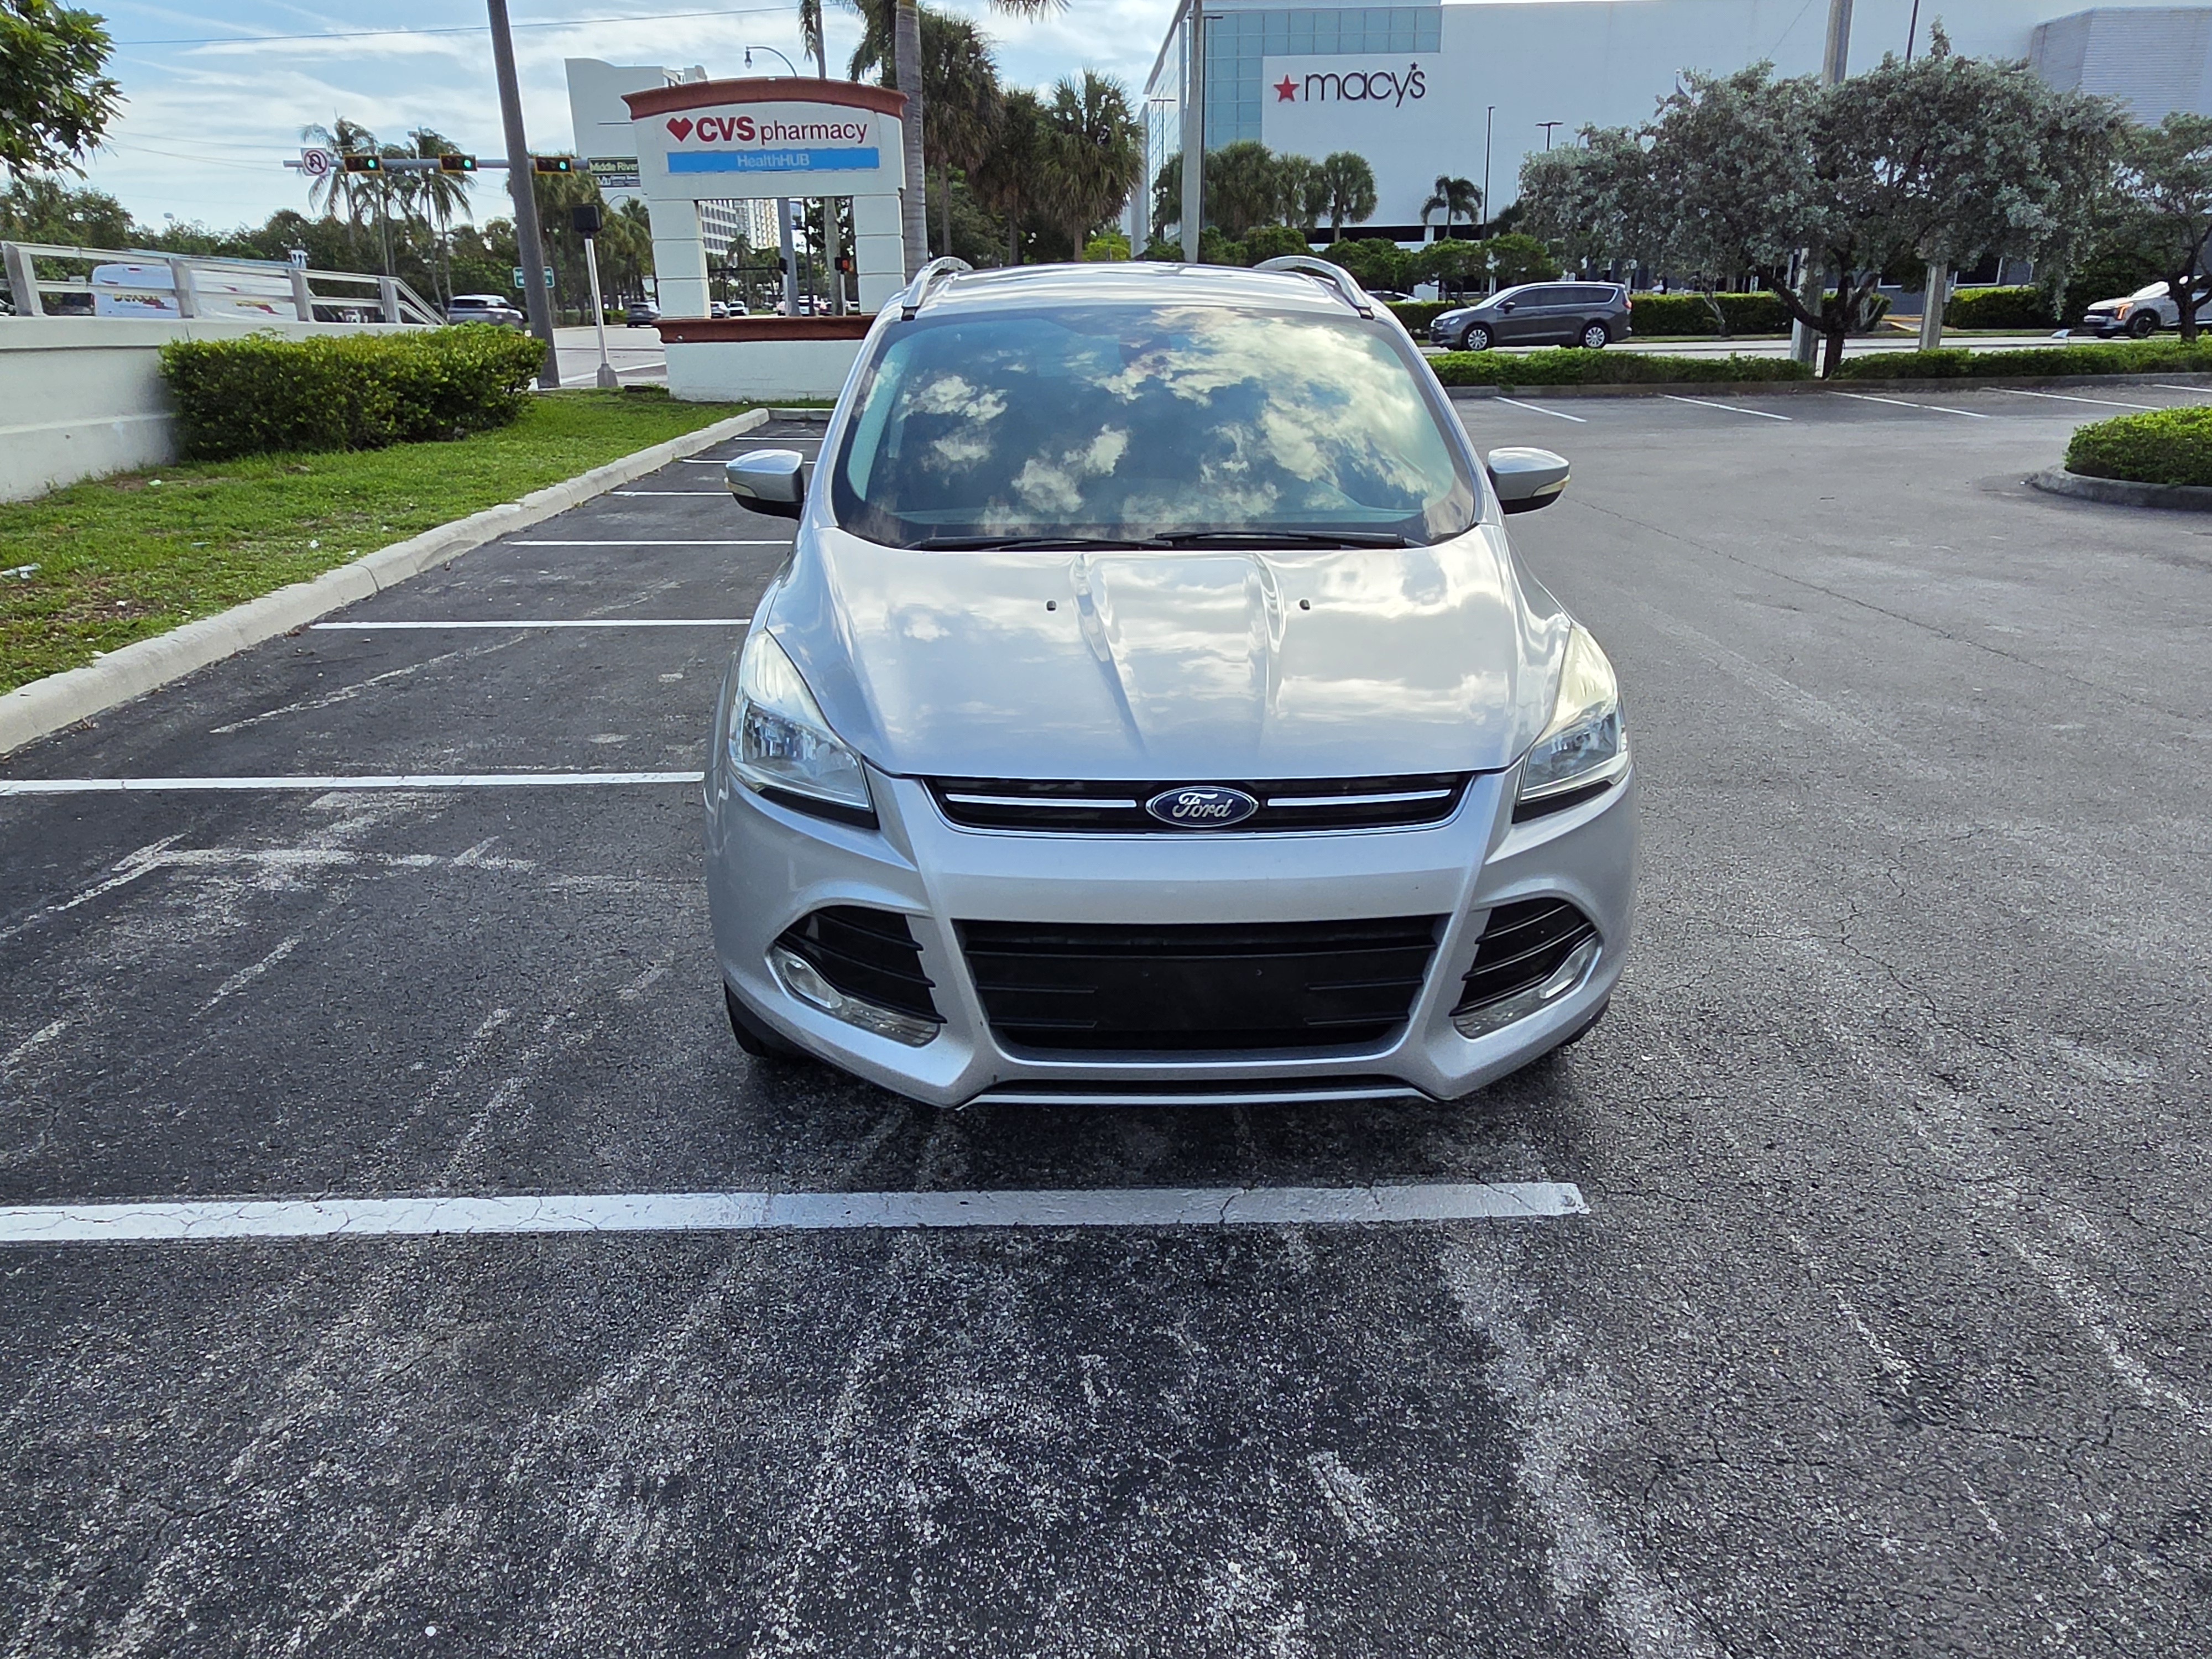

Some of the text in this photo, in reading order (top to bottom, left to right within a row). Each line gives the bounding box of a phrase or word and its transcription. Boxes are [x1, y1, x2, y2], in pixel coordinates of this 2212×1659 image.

[1305, 61, 1426, 108] macy's
[696, 116, 868, 145] CVS pharmacy
[589, 162, 617, 171] Middle
[736, 153, 811, 168] HealthHUB
[1172, 792, 1234, 818] Ford
